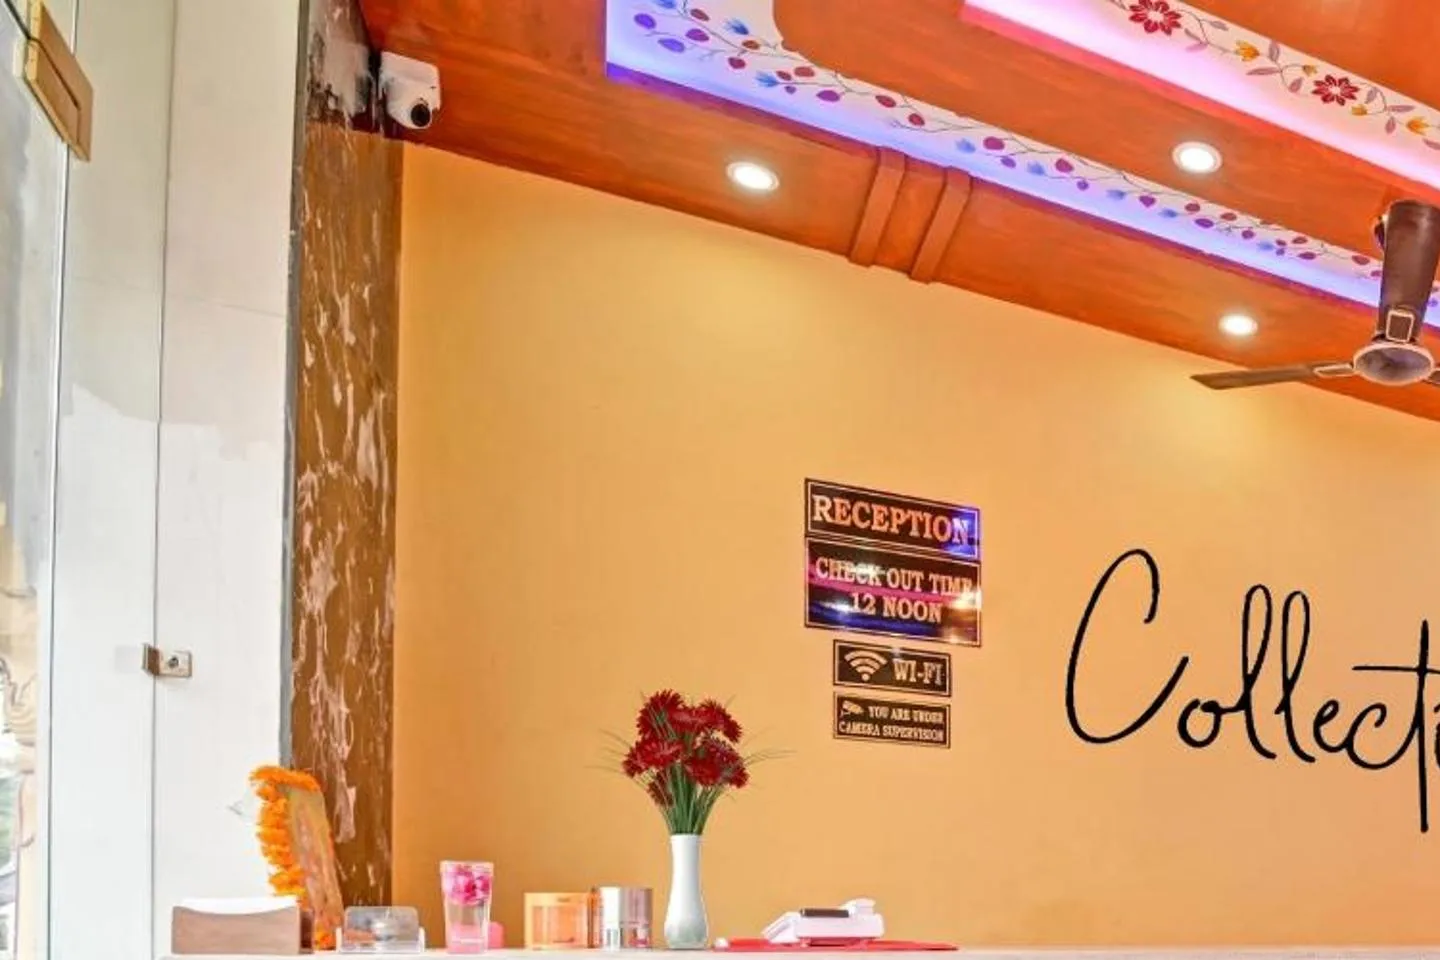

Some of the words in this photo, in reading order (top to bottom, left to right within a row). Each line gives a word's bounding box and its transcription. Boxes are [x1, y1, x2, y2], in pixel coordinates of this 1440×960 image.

[811, 494, 969, 545] RECEPTION
[815, 557, 882, 587] CHECK
[886, 568, 924, 592] OUT
[852, 592, 877, 615] 12
[882, 596, 943, 623] NOON
[892, 658, 943, 686] WI-FI
[868, 706, 890, 719] YOU
[890, 708, 911, 721] ARE
[912, 710, 943, 723] UNDER
[839, 721, 880, 736] CAMERA
[882, 725, 944, 742] SUPERVISION
